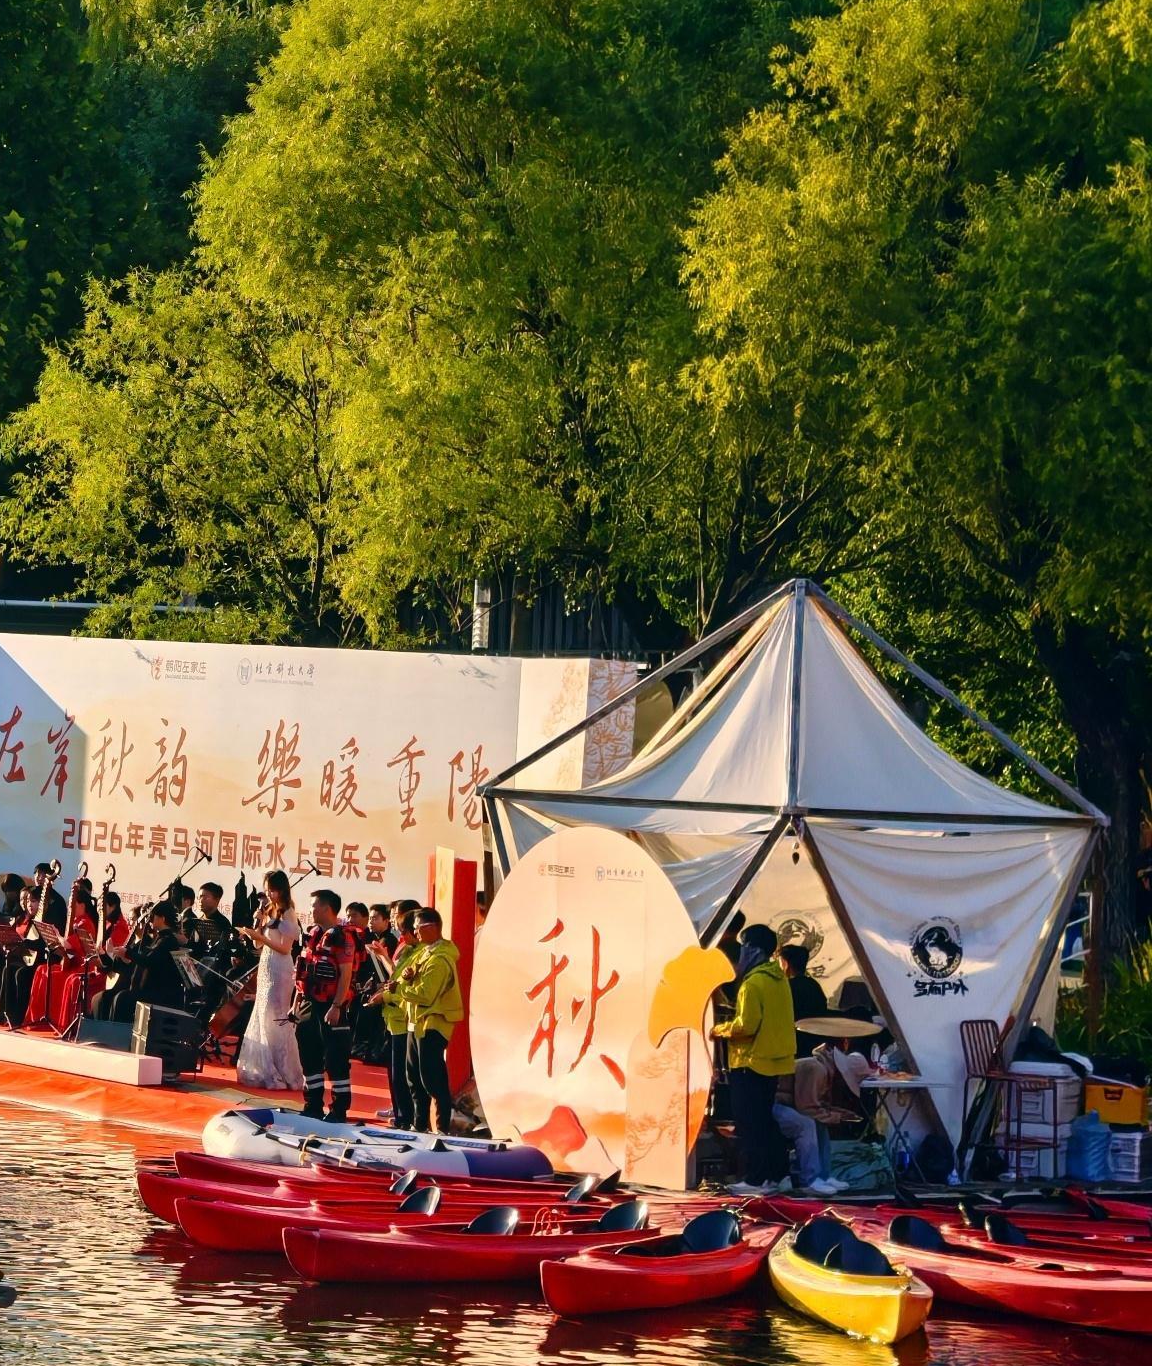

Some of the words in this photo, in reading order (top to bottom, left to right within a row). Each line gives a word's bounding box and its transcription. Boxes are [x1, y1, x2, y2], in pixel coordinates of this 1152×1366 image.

[165, 659, 207, 674] 朝阳左家庄
[256, 662, 315, 678] 北京科技大学
[61, 818, 386, 883] 2026年亮马河国际水上音乐会
[525, 918, 626, 1090] 秋
